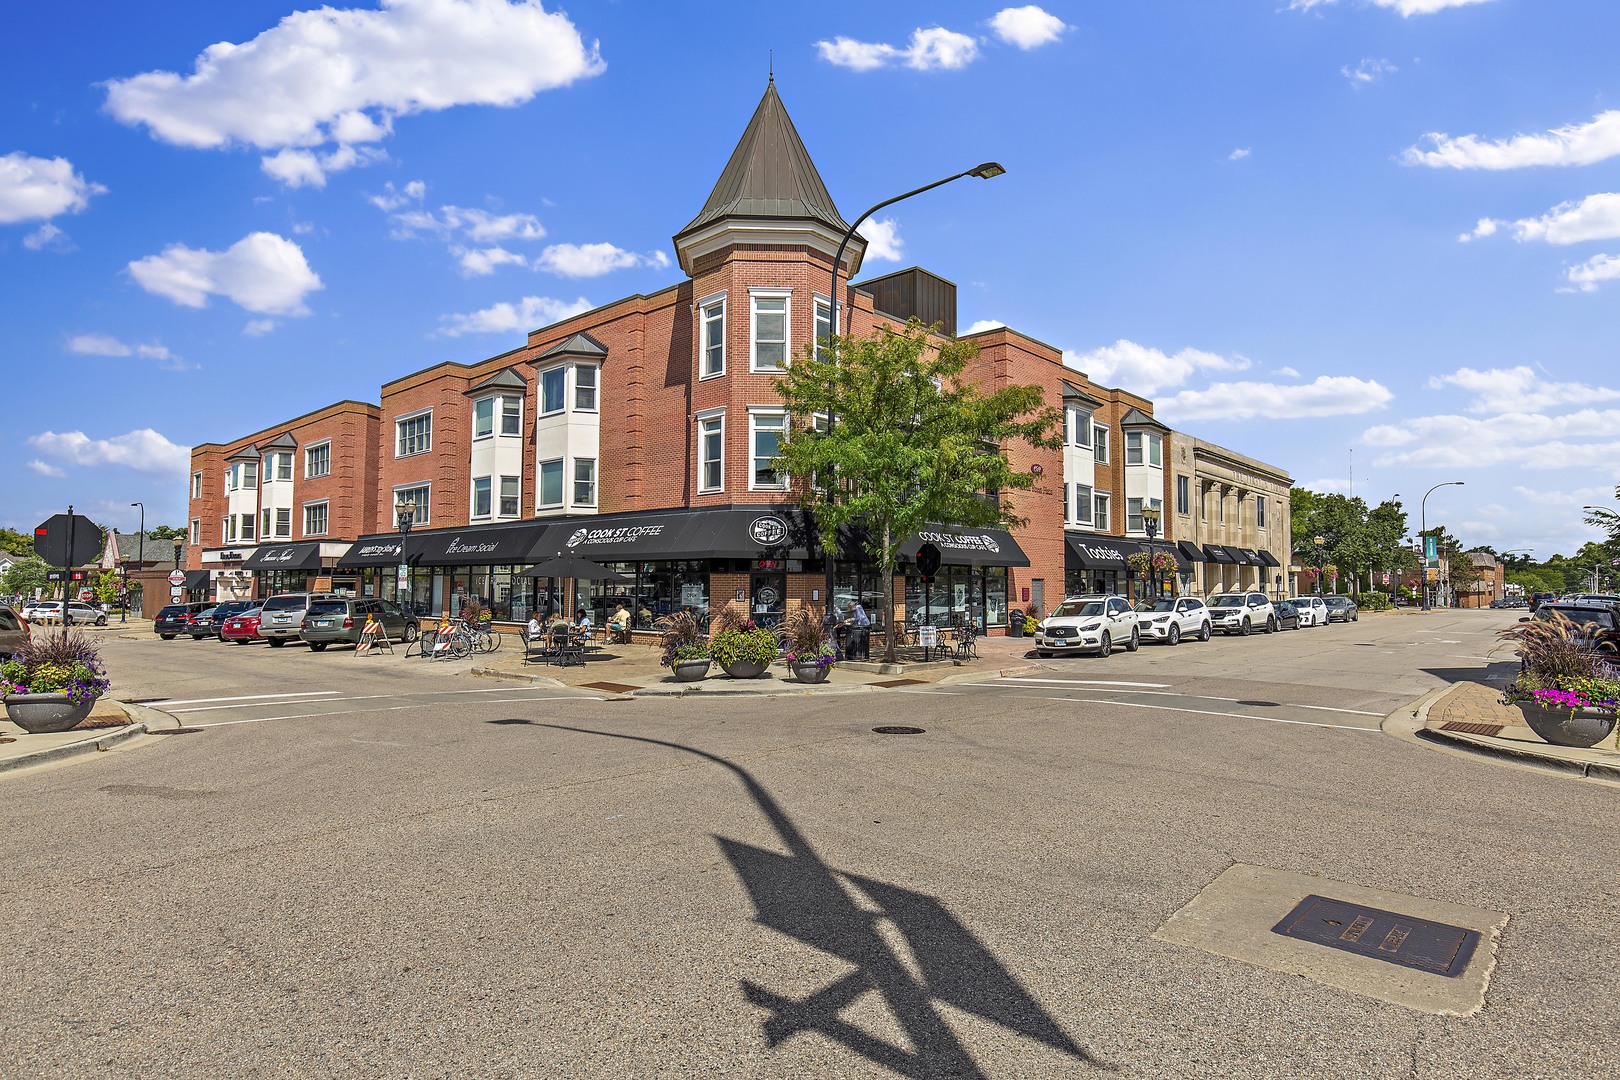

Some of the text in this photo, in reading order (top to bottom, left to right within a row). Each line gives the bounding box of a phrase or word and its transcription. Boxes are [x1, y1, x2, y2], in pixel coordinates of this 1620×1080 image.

[588, 525, 664, 539] COOK ST COFFEE
[919, 531, 983, 545] COOK ST COFFEE
[456, 543, 478, 553] Cream
[476, 541, 500, 553] Social
[1078, 543, 1124, 561] Tootsies
[475, 576, 485, 585] ICE
